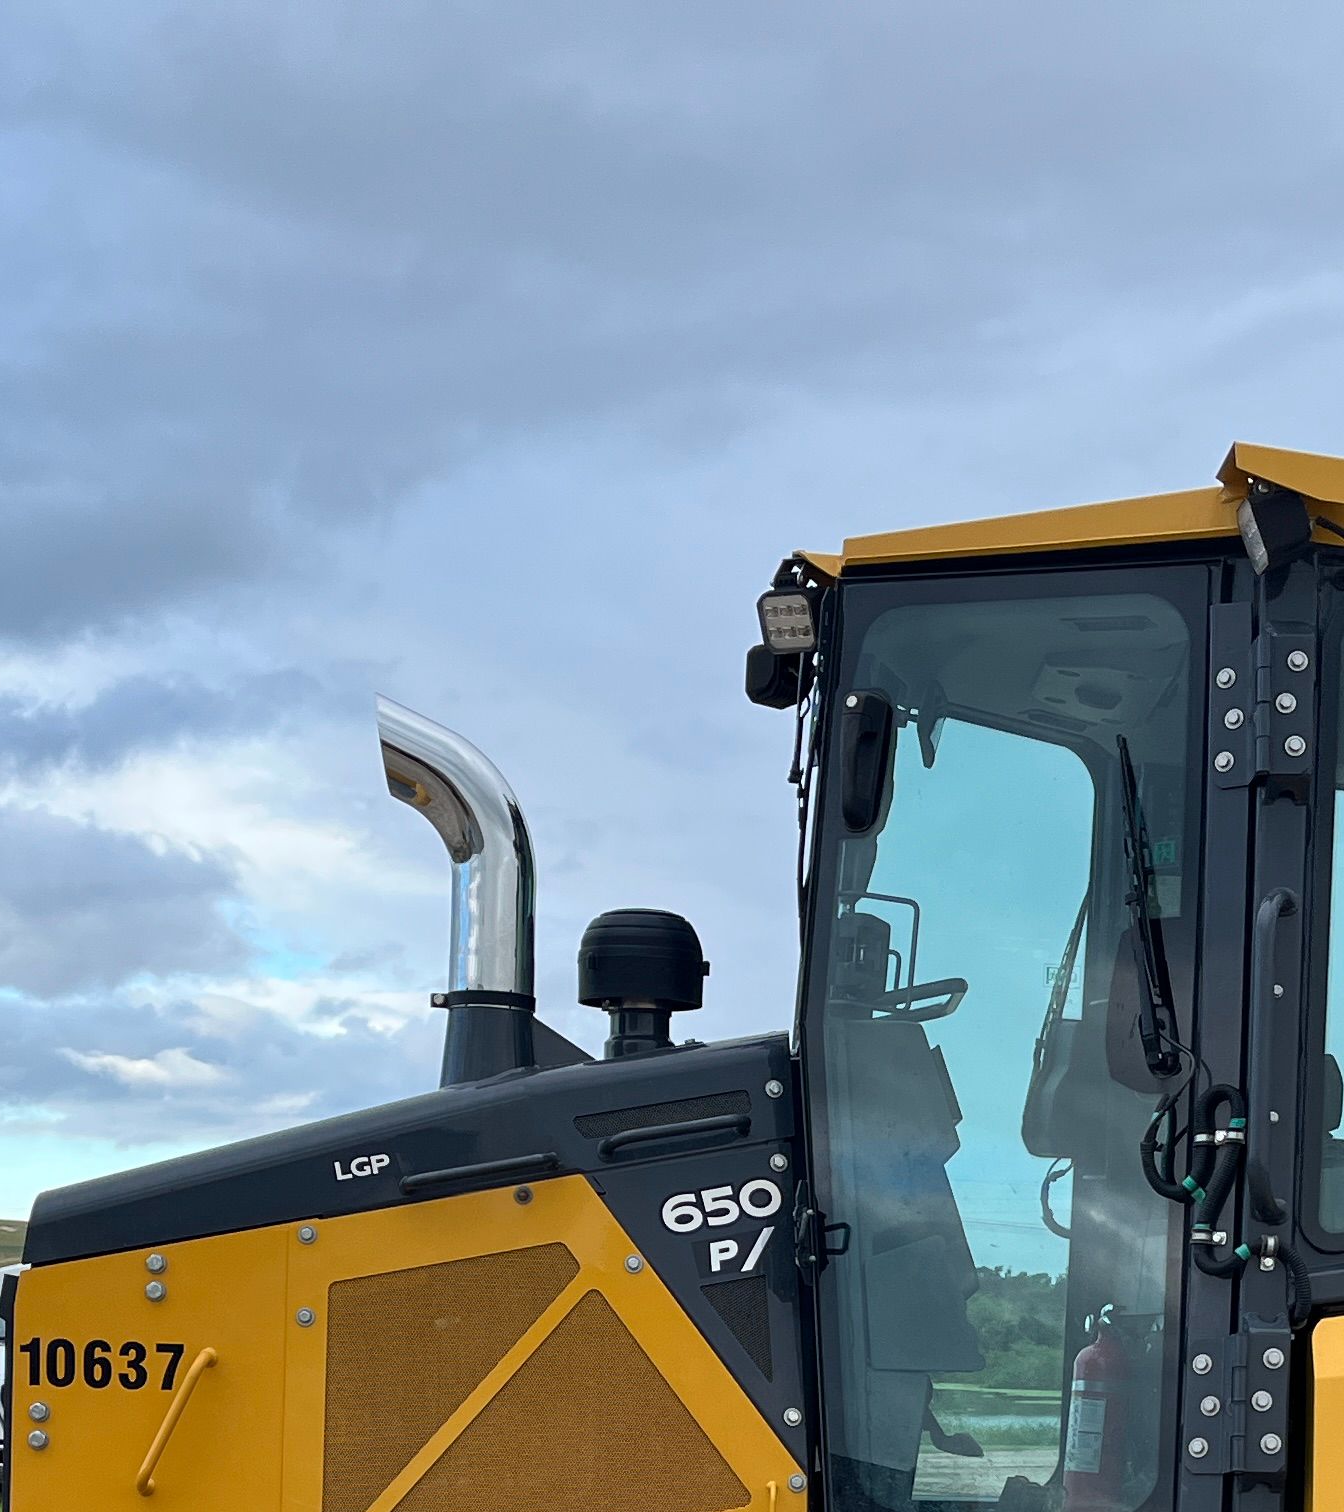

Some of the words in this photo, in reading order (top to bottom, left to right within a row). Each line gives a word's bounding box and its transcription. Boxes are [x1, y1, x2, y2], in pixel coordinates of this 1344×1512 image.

[333, 1153, 391, 1181] LGP
[661, 1178, 782, 1233] 650
[19, 1336, 185, 1391] 10637
